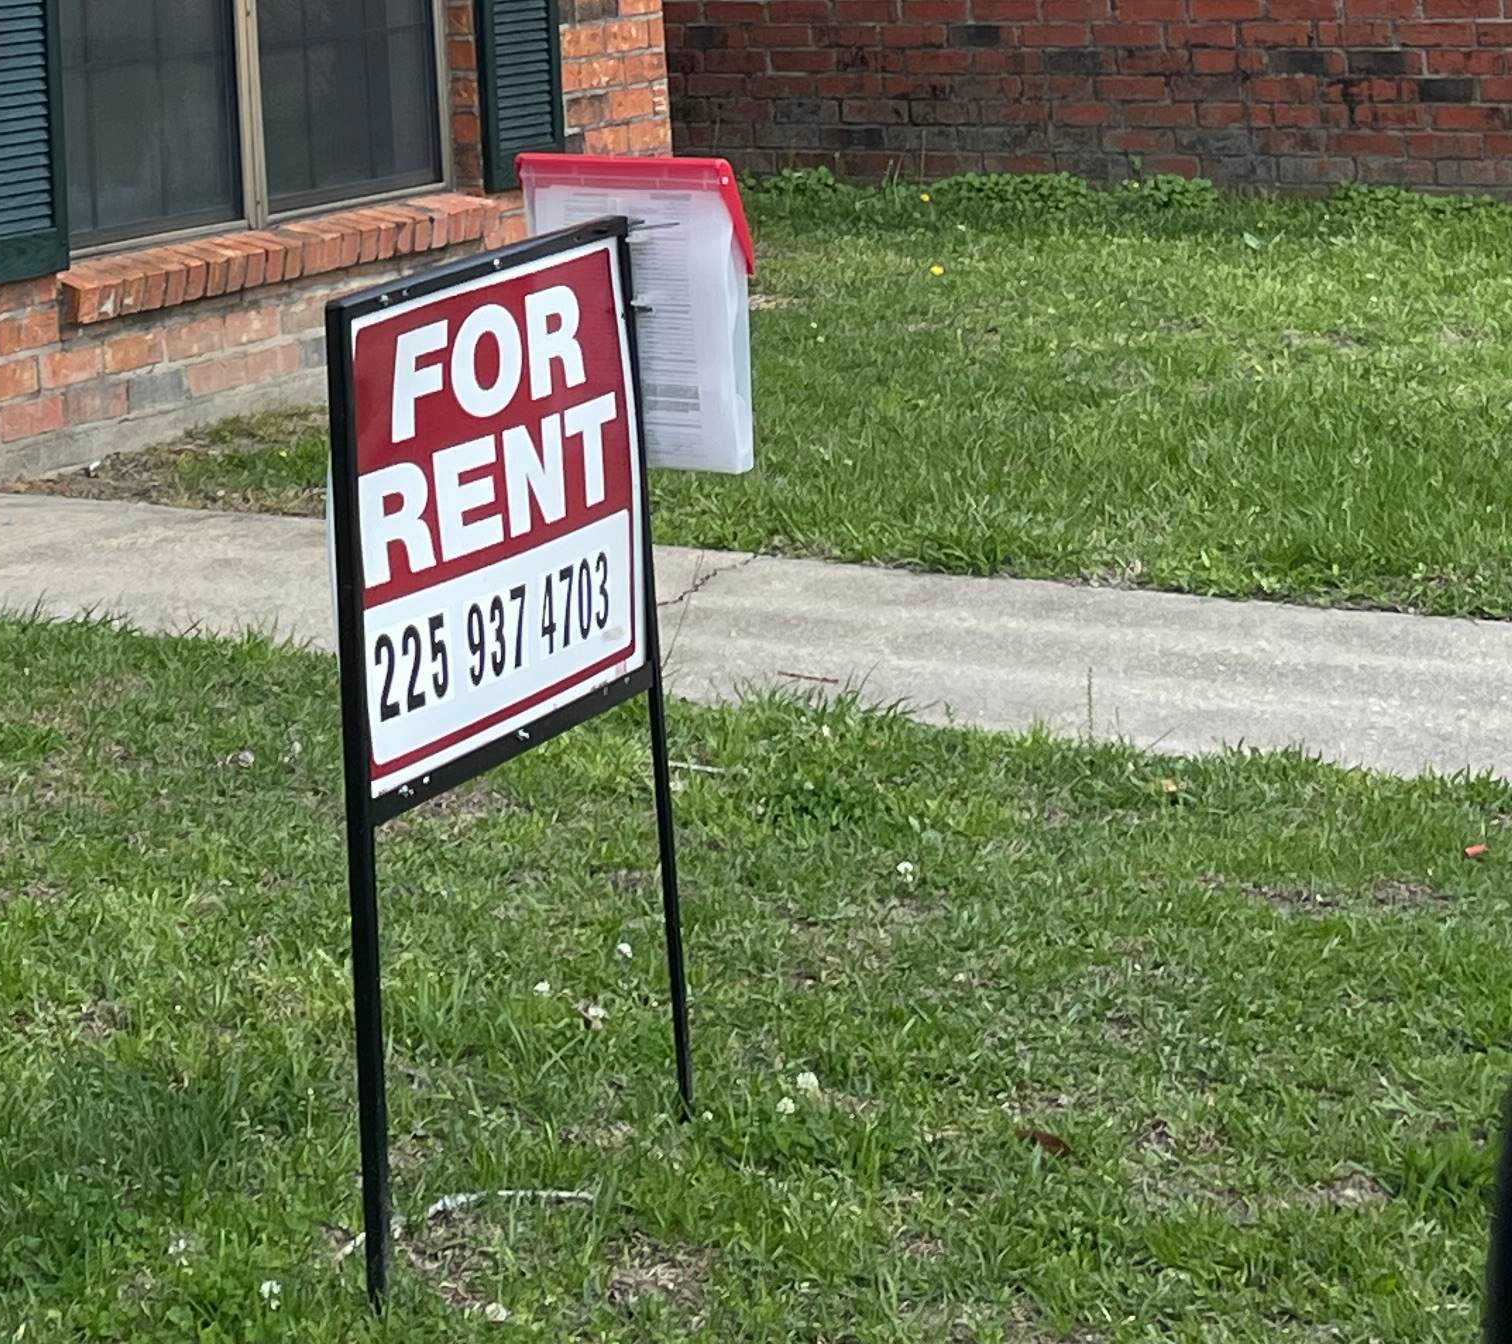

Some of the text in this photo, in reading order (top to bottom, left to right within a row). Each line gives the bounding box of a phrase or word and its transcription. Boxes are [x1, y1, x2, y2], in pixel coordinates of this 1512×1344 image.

[391, 284, 586, 443] FOR
[358, 391, 617, 589] RENT
[374, 551, 610, 723] 225 937 4703
